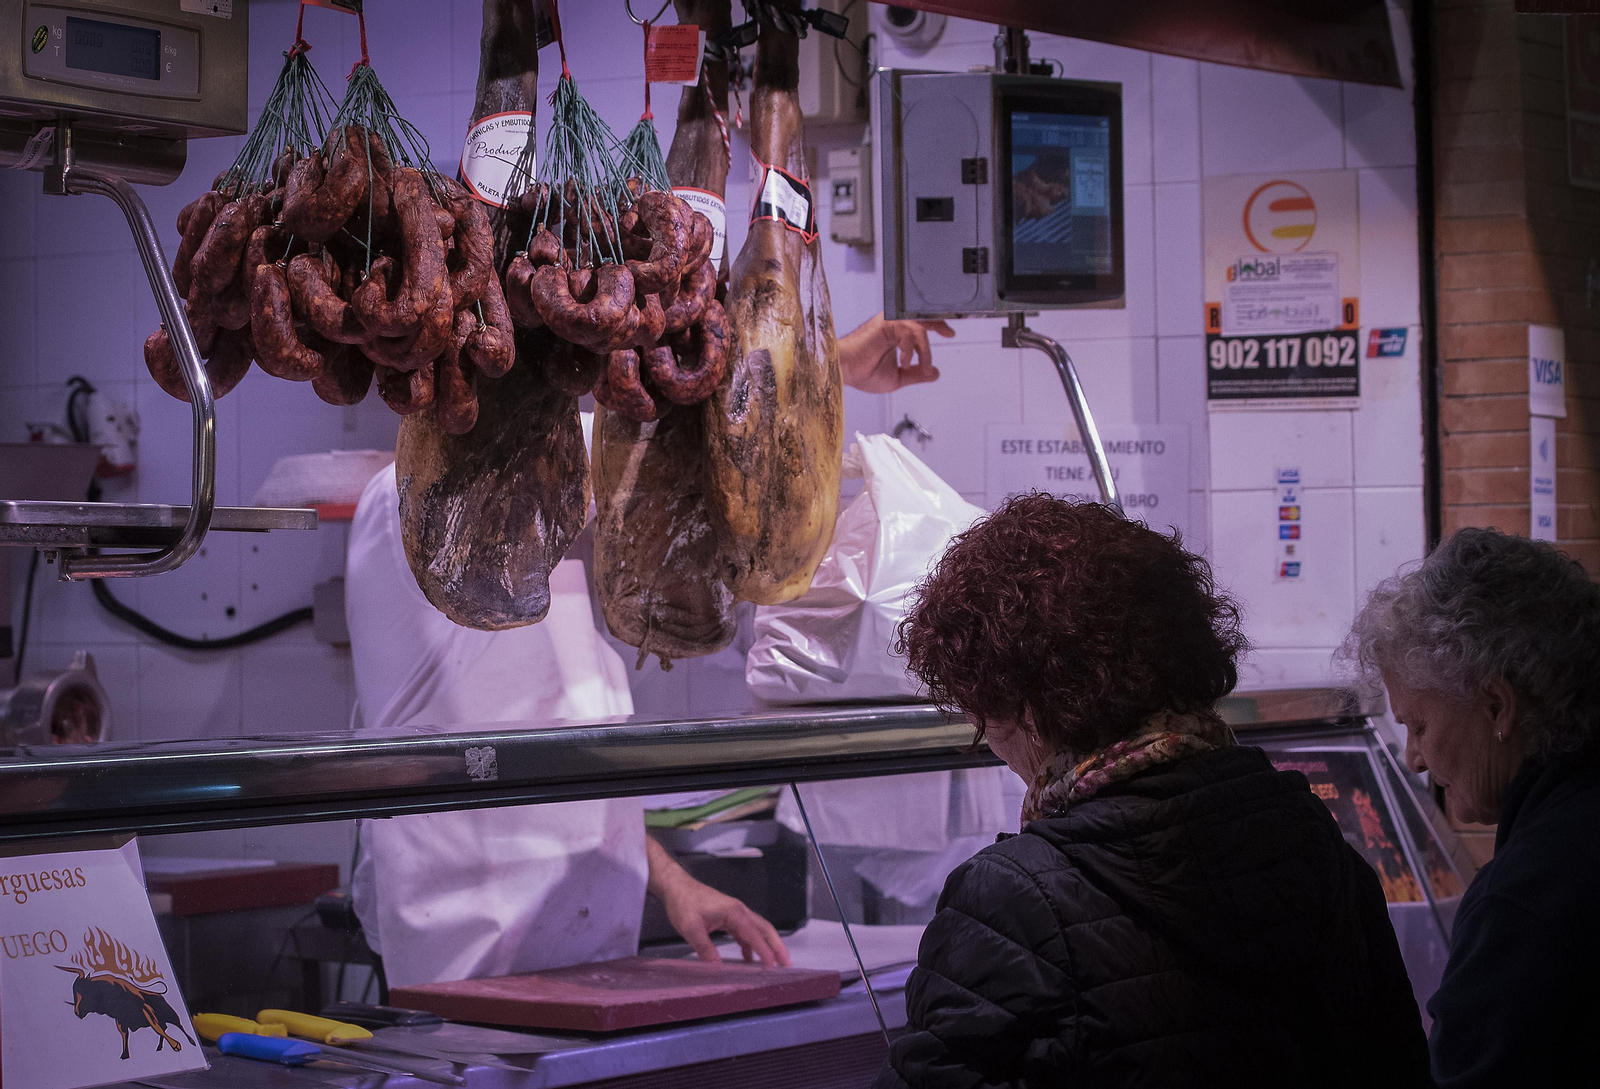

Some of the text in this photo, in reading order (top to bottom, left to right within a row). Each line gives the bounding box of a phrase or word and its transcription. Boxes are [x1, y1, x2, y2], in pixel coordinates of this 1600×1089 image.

[52, 25, 62, 39] kg
[54, 45, 60, 57] T
[165, 62, 172, 73] €
[494, 121, 500, 129] Y
[474, 141, 523, 156] Product
[477, 181, 500, 198] PALETA
[1210, 335, 1357, 370] 902 117 092
[1533, 358, 1563, 385] VISA
[1001, 439, 1033, 454] ESTE
[1045, 466, 1084, 480] TIENE
[1123, 493, 1159, 509] IBRO
[1538, 515, 1551, 528] VISA
[0, 867, 86, 905] rguesas
[0, 929, 68, 960] UEGO
